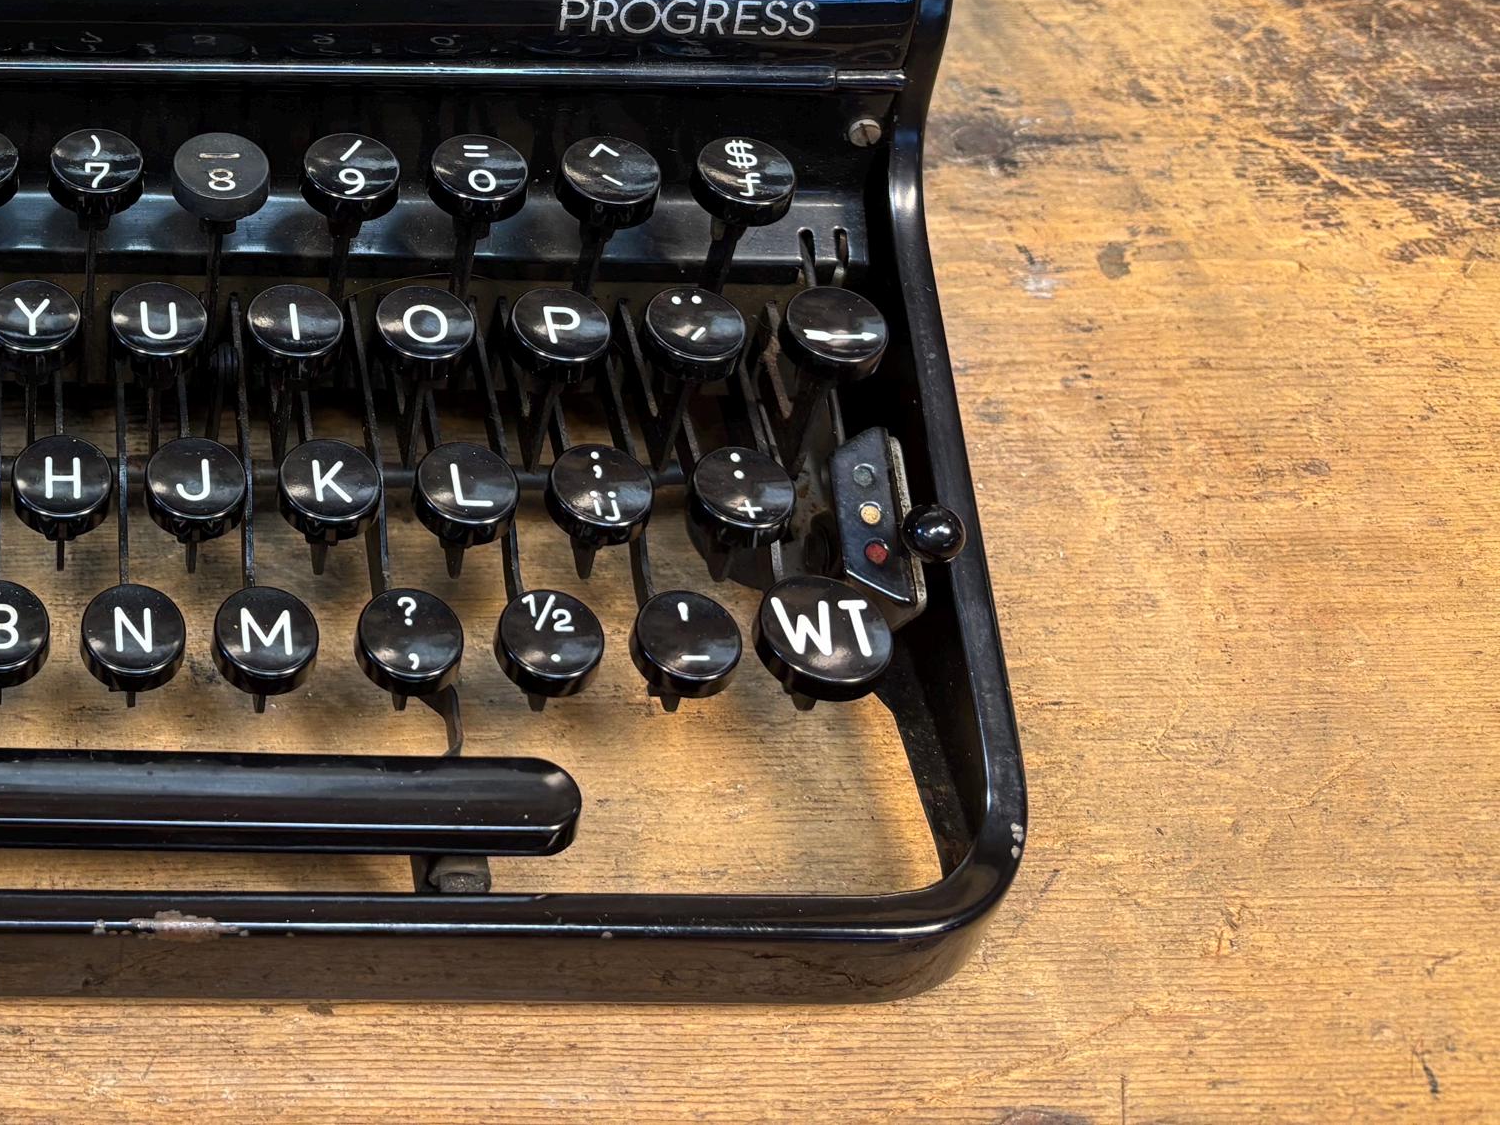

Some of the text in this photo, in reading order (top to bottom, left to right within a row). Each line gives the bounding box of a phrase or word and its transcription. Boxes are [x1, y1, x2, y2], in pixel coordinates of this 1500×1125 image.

[339, 139, 363, 162] /
[462, 144, 490, 158] =
[724, 139, 758, 170] $
[84, 162, 110, 189] 7
[208, 168, 237, 191] 8
[338, 168, 366, 195] 9
[14, 297, 50, 336] Y
[139, 301, 178, 340] U
[289, 303, 301, 341] I
[400, 304, 449, 343] O
[539, 305, 581, 344] P
[44, 456, 82, 499] H
[175, 458, 211, 501] J
[311, 459, 353, 503] K
[446, 463, 494, 507] L
[730, 452, 745, 480] :
[735, 497, 763, 519] +
[114, 606, 153, 653] N
[397, 596, 417, 626] ?
[770, 596, 873, 660] WT
[236, 607, 293, 656] M
